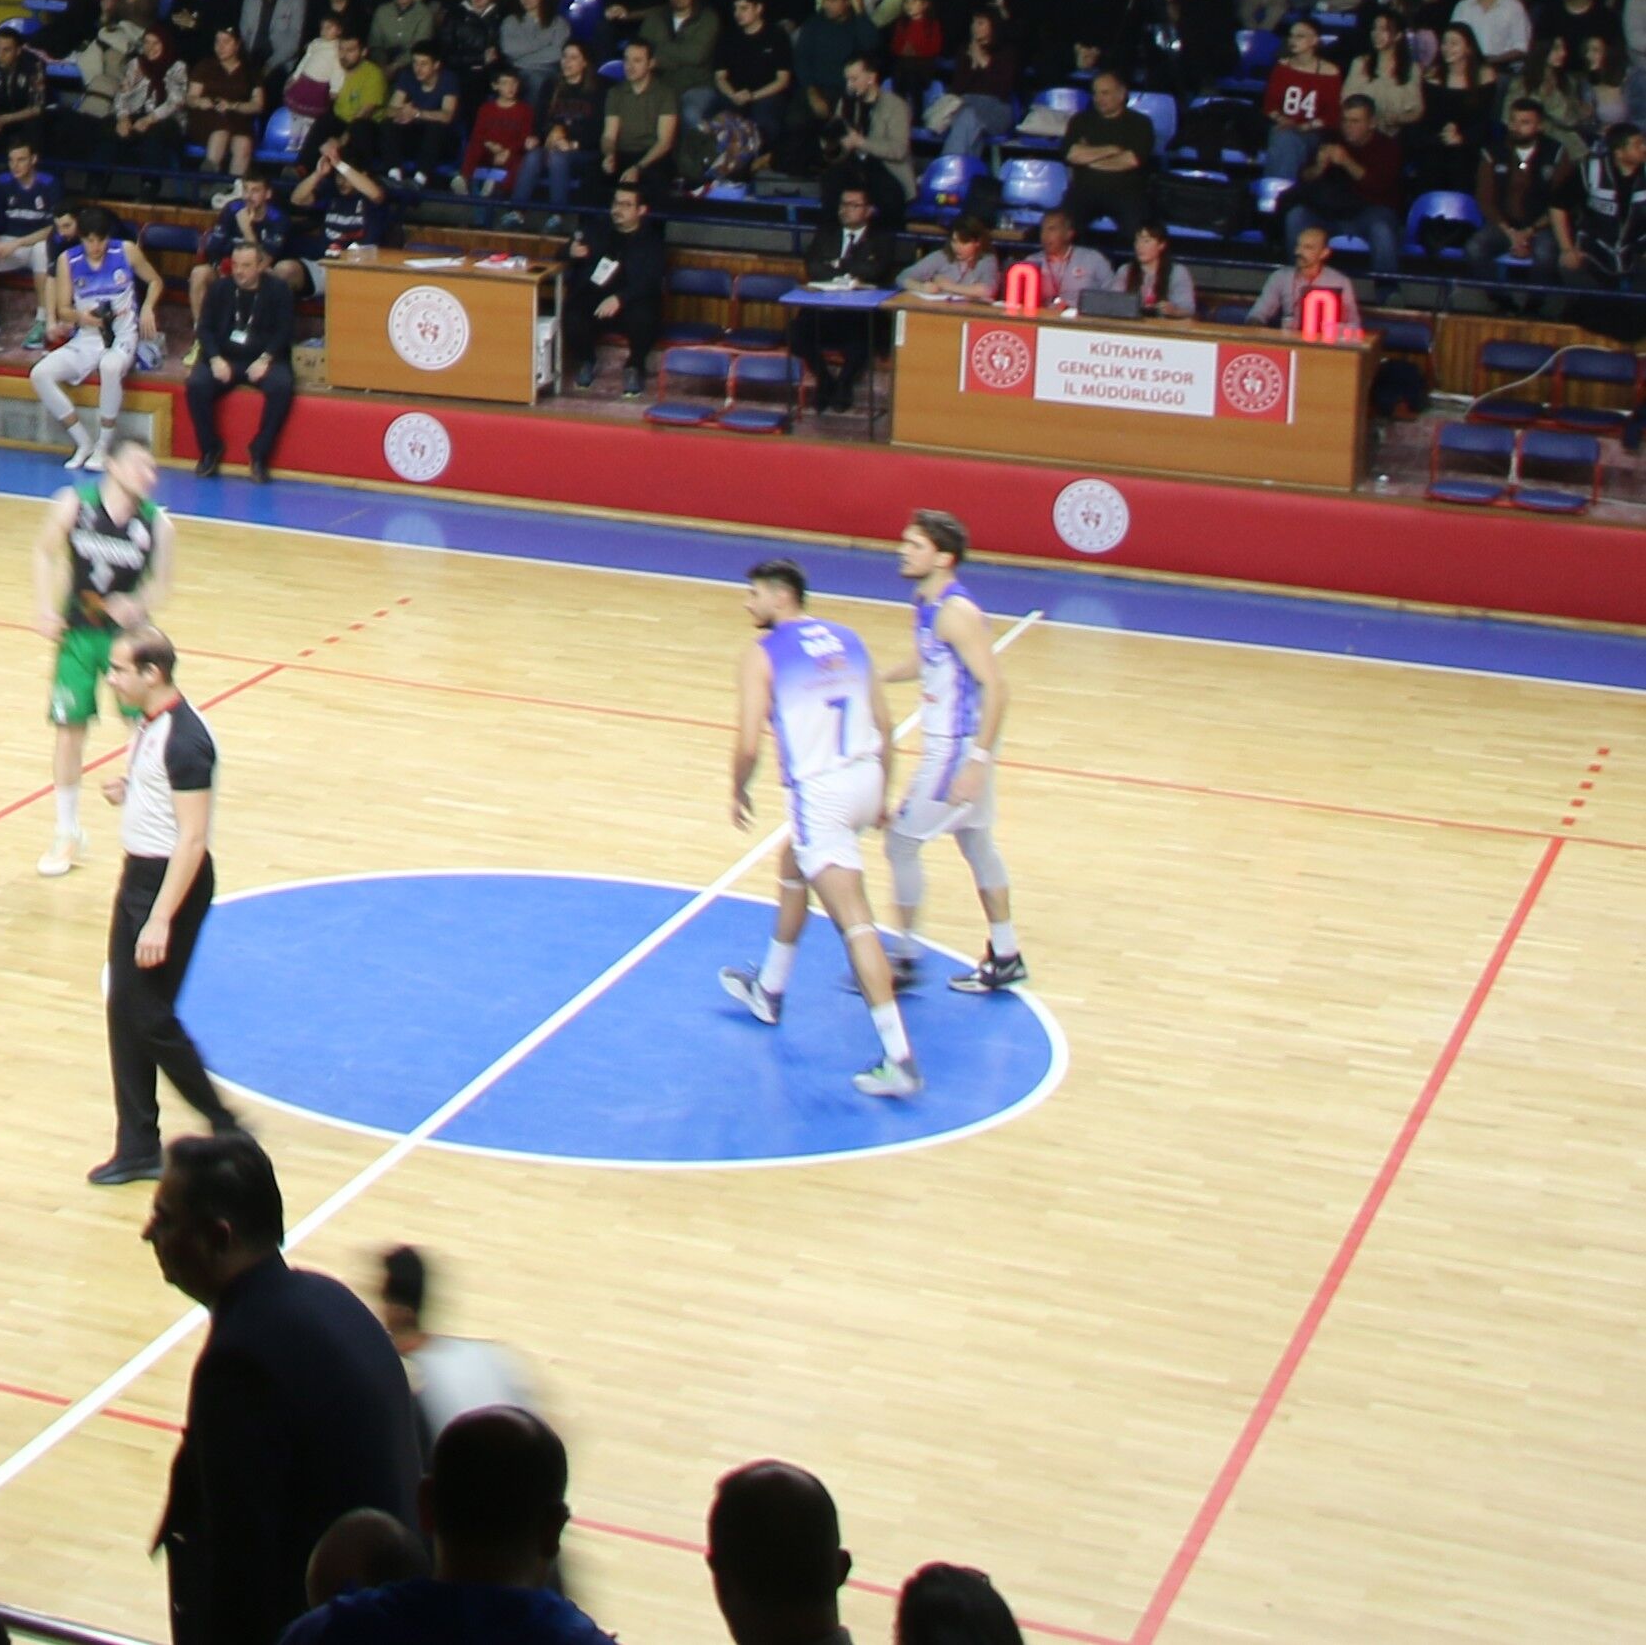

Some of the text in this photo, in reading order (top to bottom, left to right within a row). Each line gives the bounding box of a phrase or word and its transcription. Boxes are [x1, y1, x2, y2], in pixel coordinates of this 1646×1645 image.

[1283, 86, 1317, 119] 84
[1089, 341, 1163, 362] KÜTAHYA
[1058, 360, 1194, 386] GENÇLİK VE SPOR
[1063, 380, 1186, 405] İL MÜDÜRLÜĞÜ
[826, 696, 850, 758] 7
